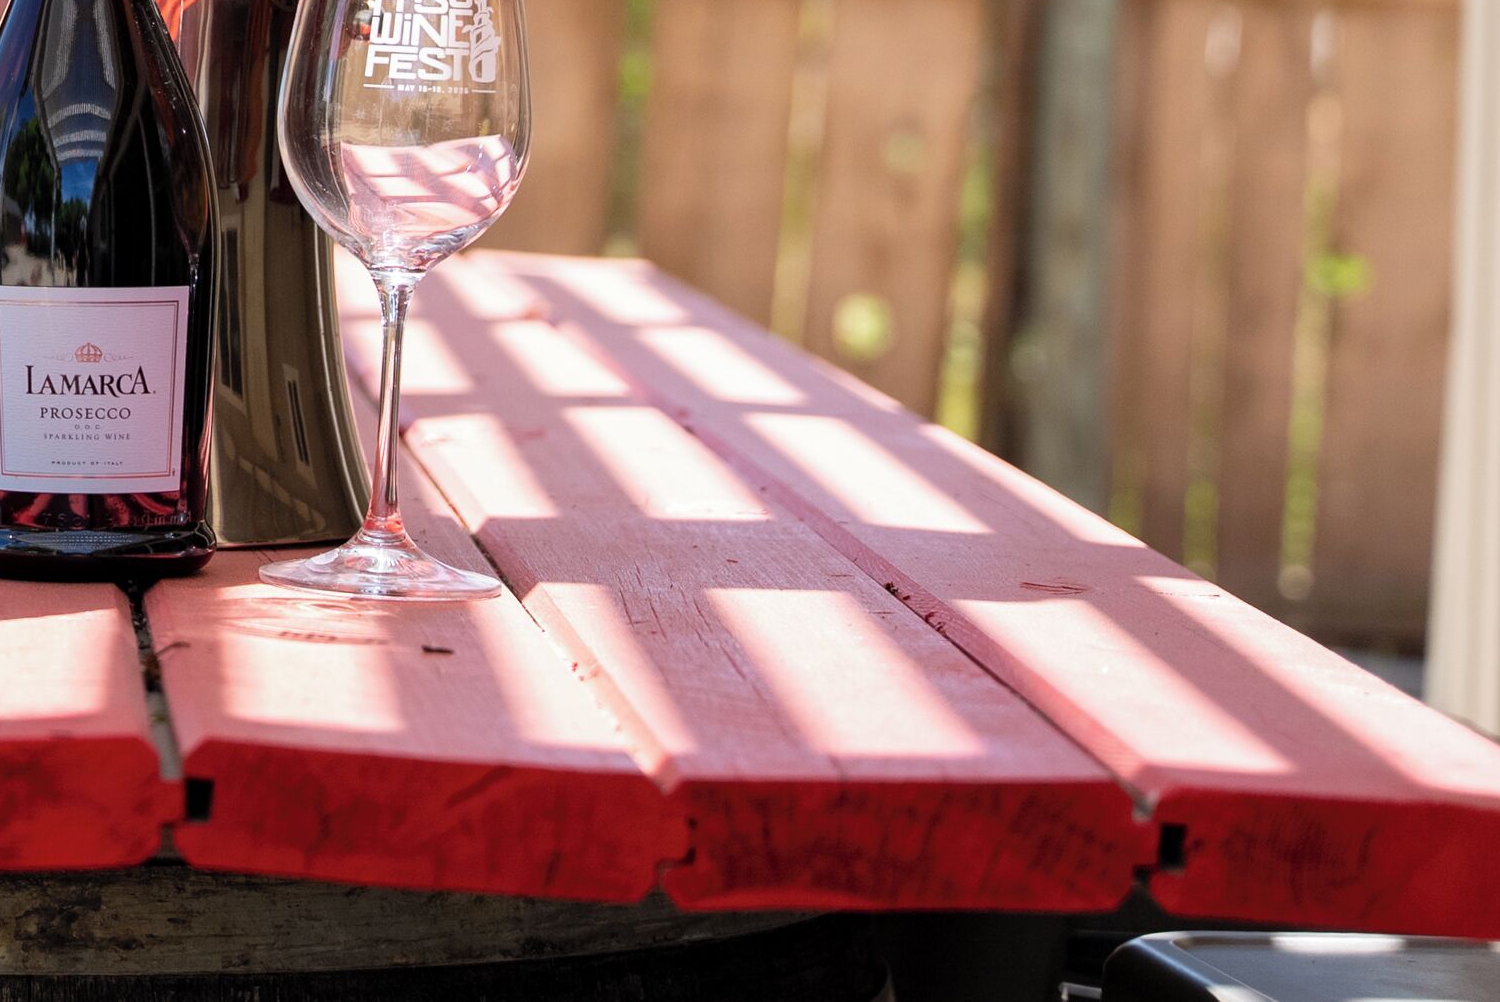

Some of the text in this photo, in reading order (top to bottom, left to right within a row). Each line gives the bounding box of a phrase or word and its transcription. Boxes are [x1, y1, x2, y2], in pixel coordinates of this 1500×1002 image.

[364, 44, 470, 82] FEST
[397, 83, 416, 92] MAY
[40, 407, 131, 420] PROSECCO
[43, 433, 100, 441] SPARKLING
